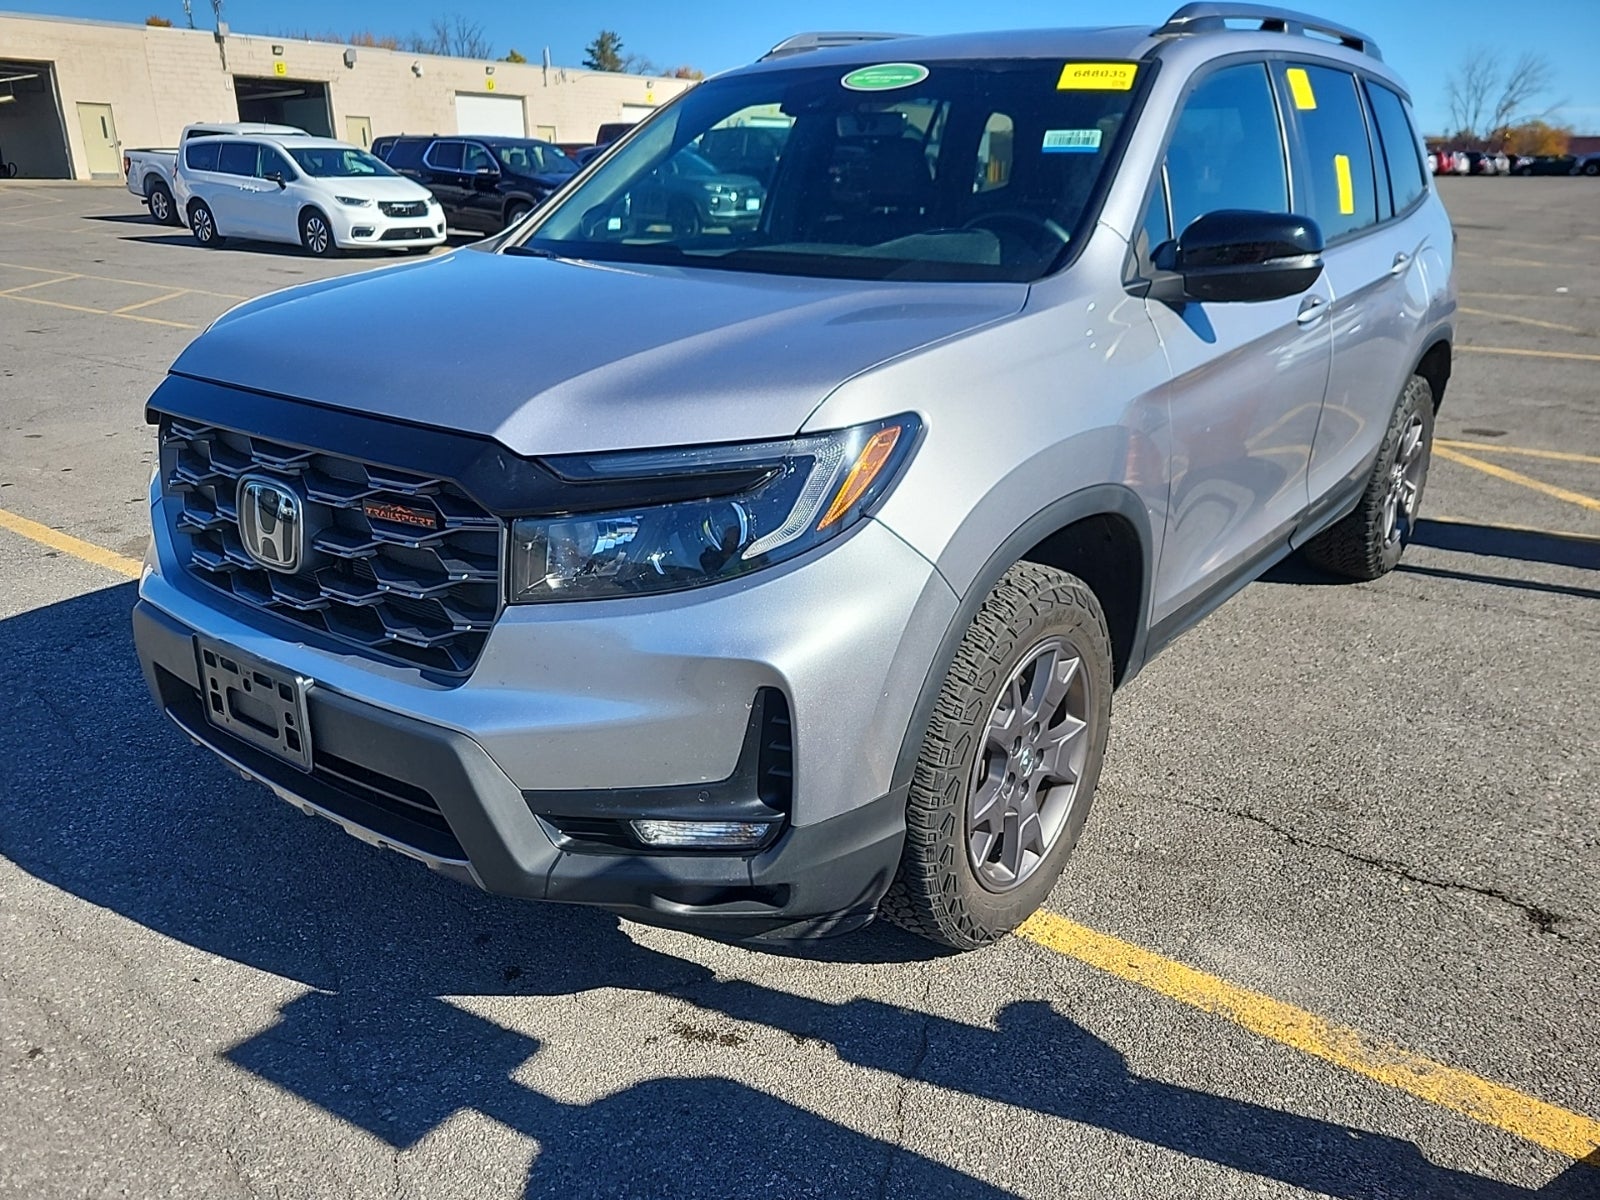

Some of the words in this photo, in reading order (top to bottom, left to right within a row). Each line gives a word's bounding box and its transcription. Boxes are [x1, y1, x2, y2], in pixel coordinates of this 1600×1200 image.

[276, 63, 285, 74] E
[1073, 69, 1127, 78] 688035
[365, 506, 435, 527] TRAILSPORT
